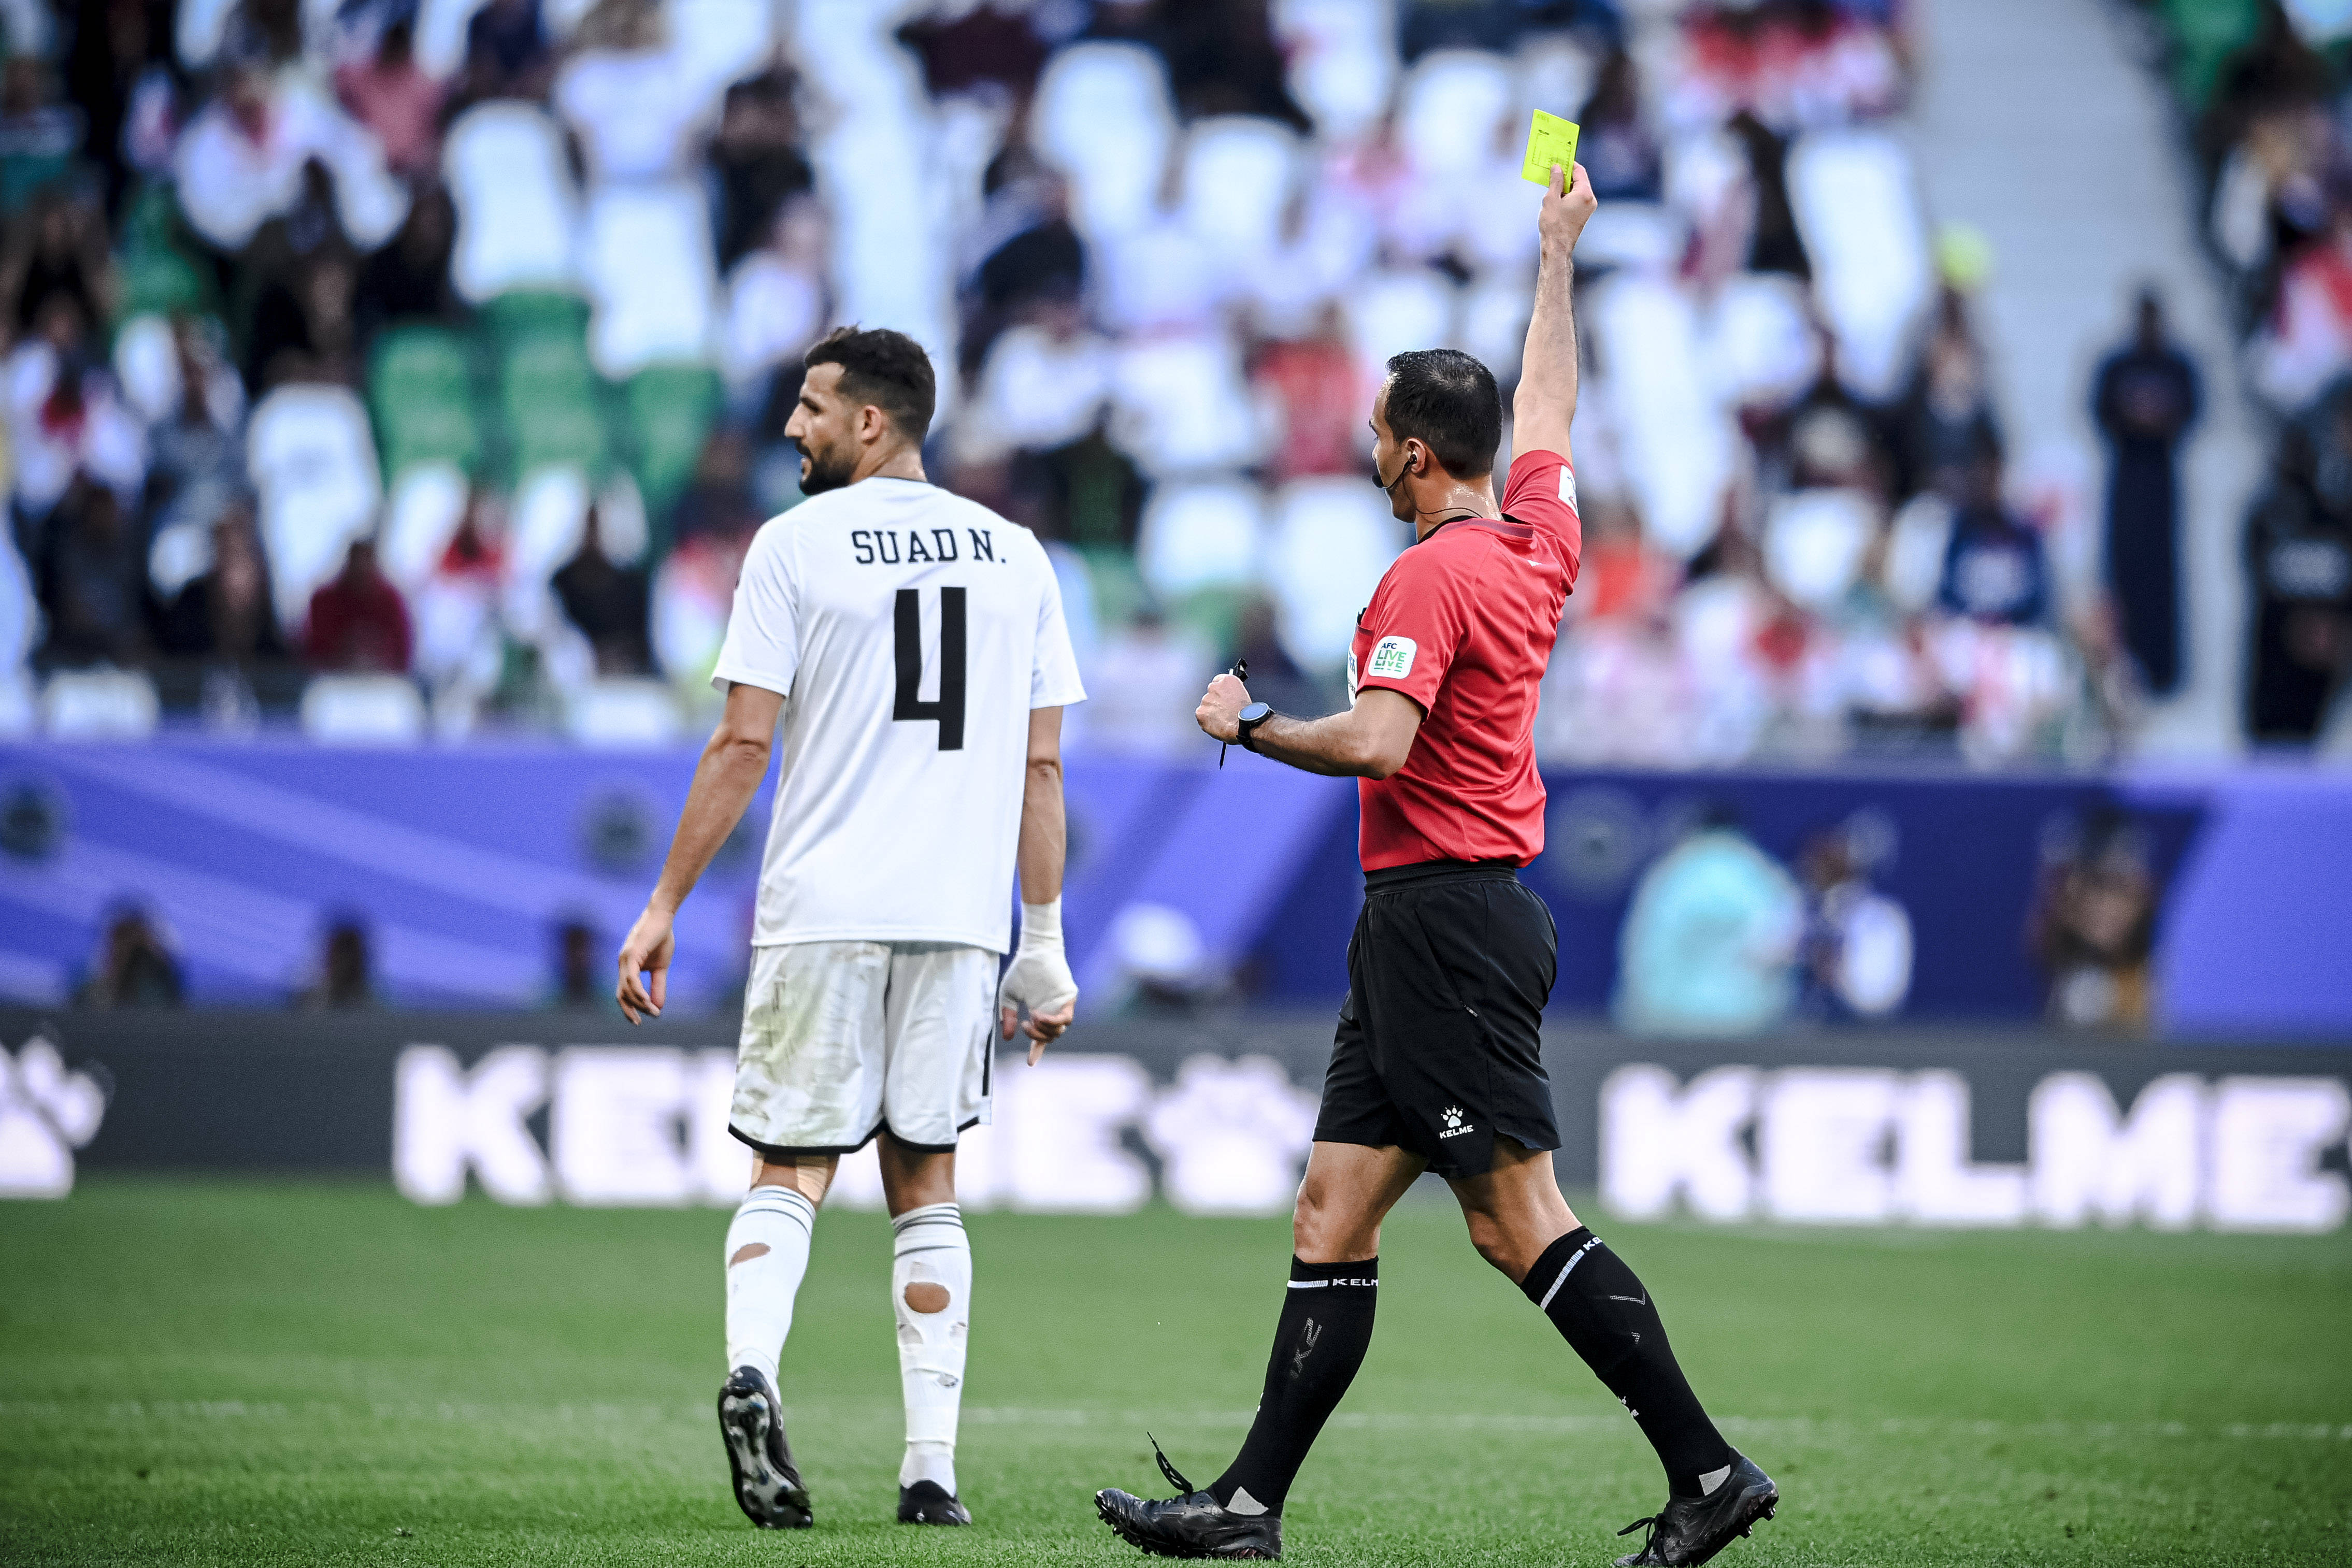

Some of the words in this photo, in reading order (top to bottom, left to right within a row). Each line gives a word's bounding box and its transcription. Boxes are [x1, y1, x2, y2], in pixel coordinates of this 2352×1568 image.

[852, 529, 958, 564] SUAD
[968, 528, 1007, 564] N.
[893, 586, 967, 751] 4
[1377, 650, 1407, 661] LIVE
[1439, 1125, 1474, 1139] KELME
[1599, 1064, 2349, 1231] KELME
